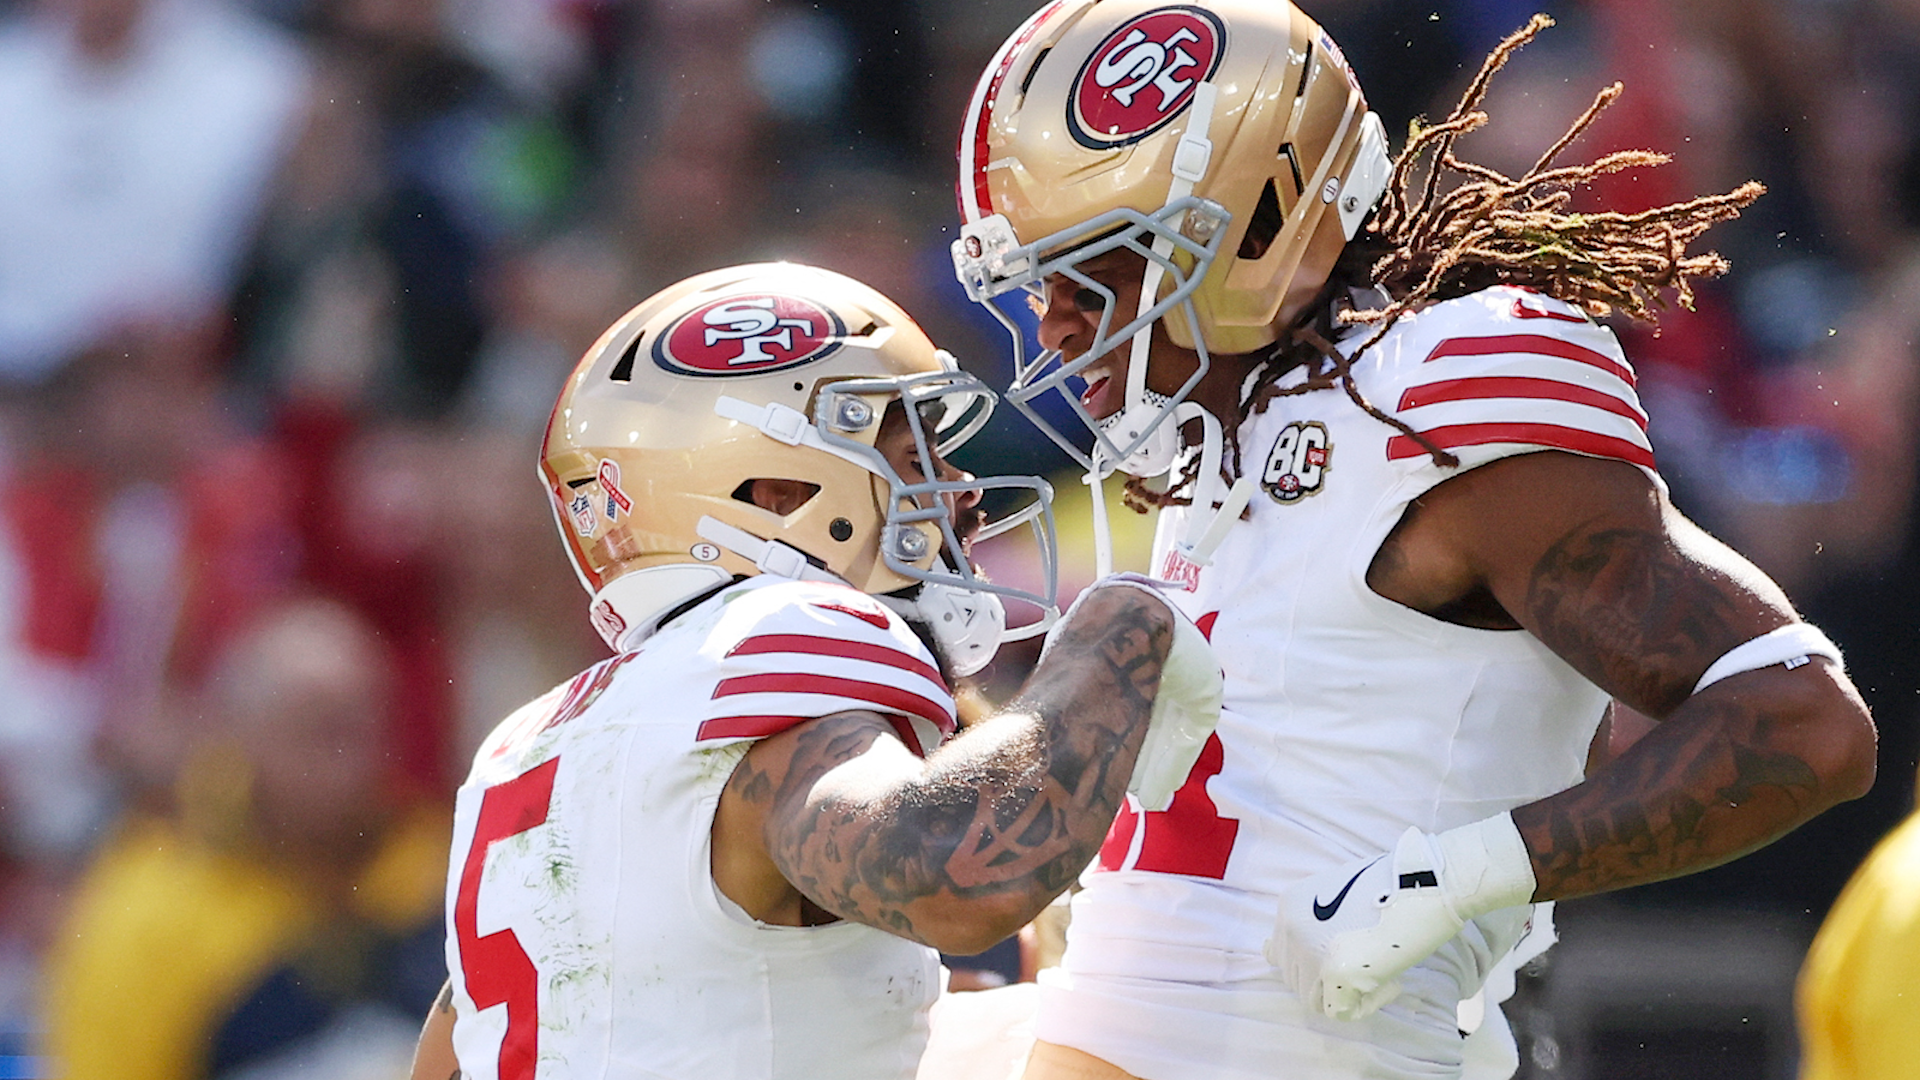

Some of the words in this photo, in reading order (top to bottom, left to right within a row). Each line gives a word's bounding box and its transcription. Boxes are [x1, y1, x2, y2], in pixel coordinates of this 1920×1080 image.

[1094, 26, 1200, 112] SF
[703, 297, 814, 366] SF
[702, 546, 711, 559] 5
[455, 754, 562, 1080] 5
